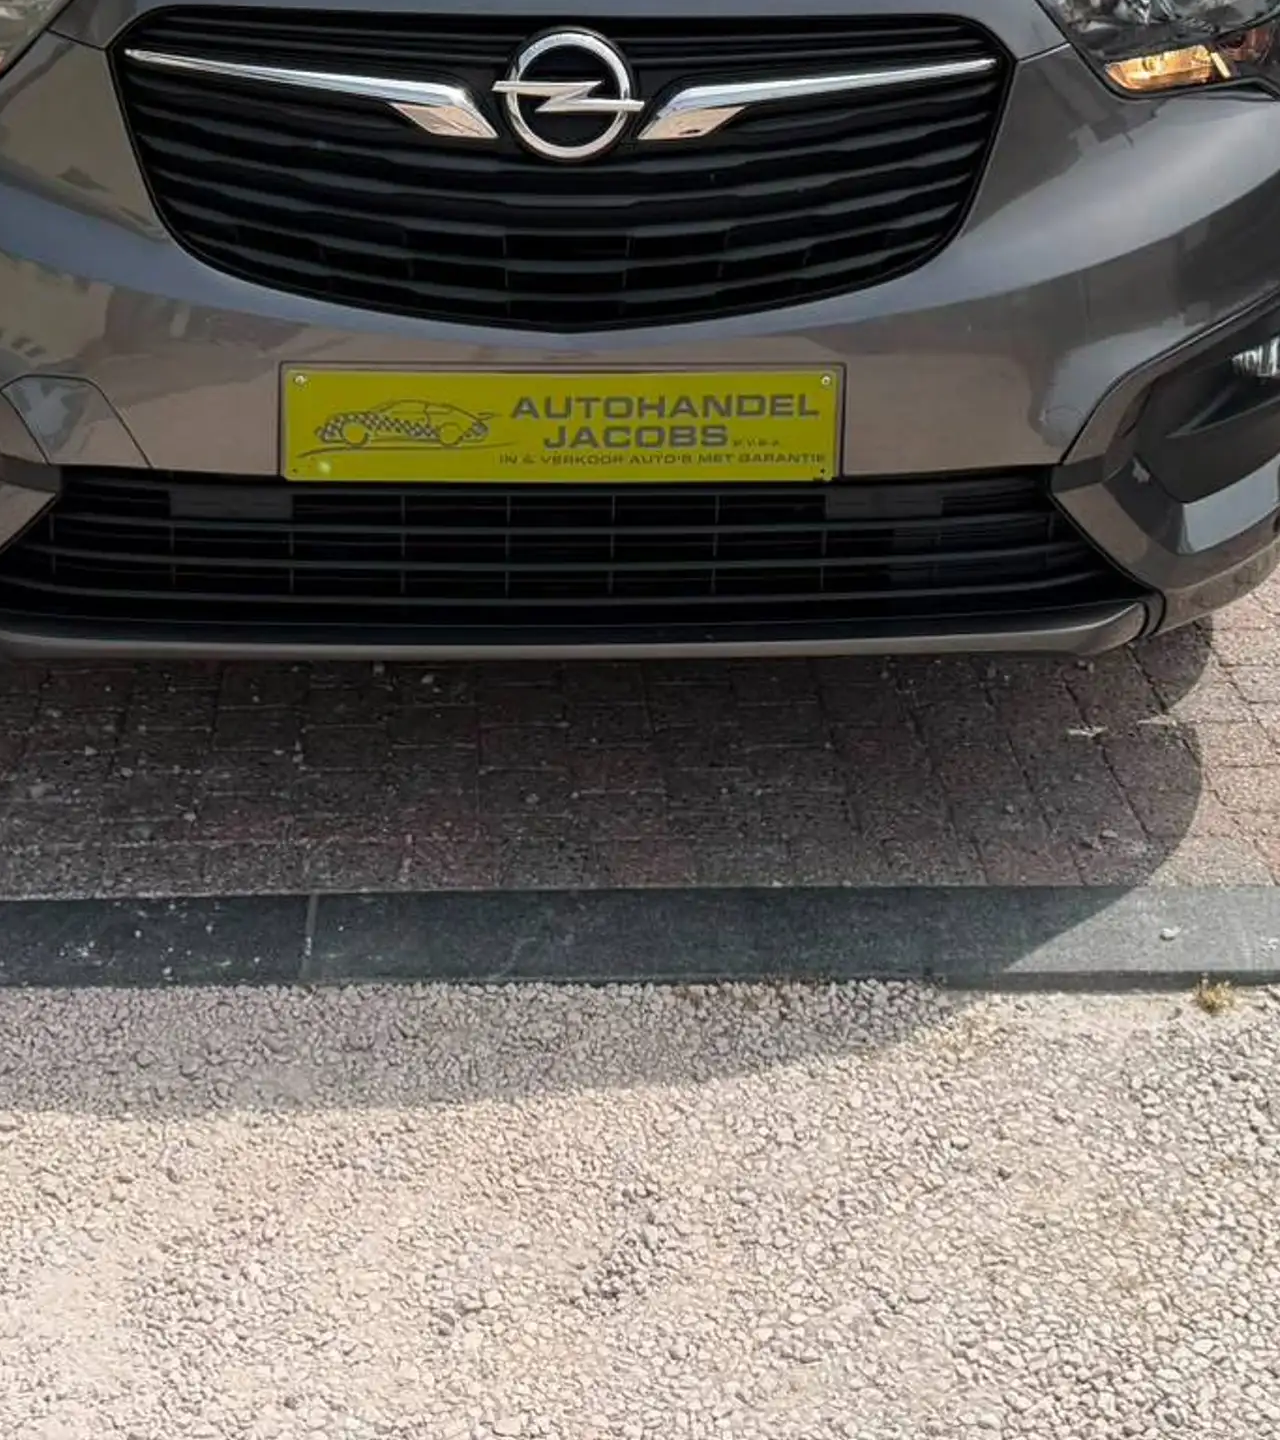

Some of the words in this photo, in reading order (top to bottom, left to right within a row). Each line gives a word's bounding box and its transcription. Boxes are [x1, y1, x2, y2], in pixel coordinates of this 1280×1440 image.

[511, 394, 819, 420] AUTOHANDEL
[544, 425, 728, 448] JACOBS
[540, 453, 625, 465] VERKOOP
[698, 452, 732, 464] MET
[738, 452, 826, 464] GARANTIE
